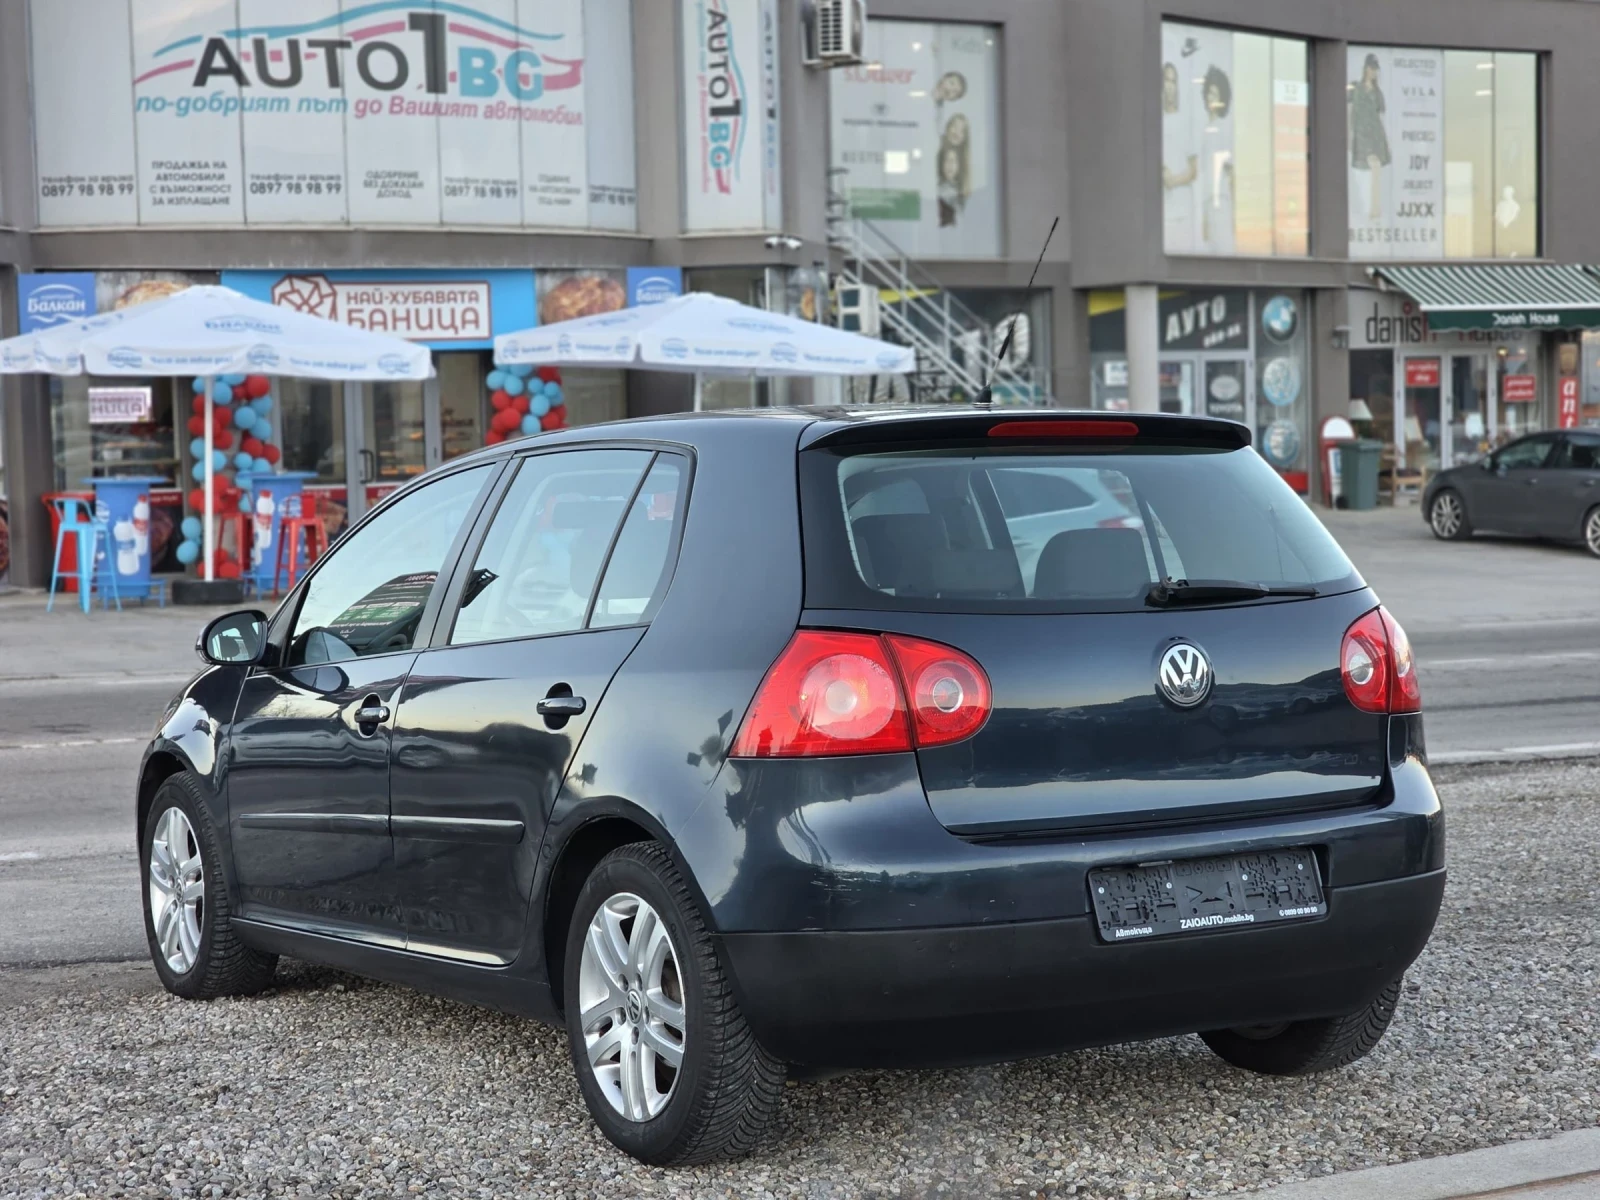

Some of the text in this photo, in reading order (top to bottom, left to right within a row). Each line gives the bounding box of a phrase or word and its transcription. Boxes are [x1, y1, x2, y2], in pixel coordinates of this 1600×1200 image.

[1402, 86, 1435, 96] VILA
[136, 91, 583, 125] по-добрият път до Вашият автомобил
[150, 160, 226, 171] ПРОДАЖБА НА
[154, 173, 225, 182] АВТОМОБИЛИ
[365, 171, 419, 179] ОДОБРЕНИЕ
[41, 182, 133, 198] 0897 98 98 99
[148, 185, 156, 194] С
[249, 182, 342, 195] 0897 98 98 99
[363, 180, 424, 189] БЕЗ ДОКАЗАН
[151, 196, 230, 207] ЗА ИЗПЛАЩАНЕ
[1396, 202, 1435, 217] JJXX
[1348, 227, 1438, 241] BESTSELLER
[346, 287, 480, 305] НАЙ-ХУБАВАТА
[27, 298, 85, 313] Балкан
[347, 308, 480, 335] БАНИЦА
[1115, 926, 1153, 938] Автокъща
